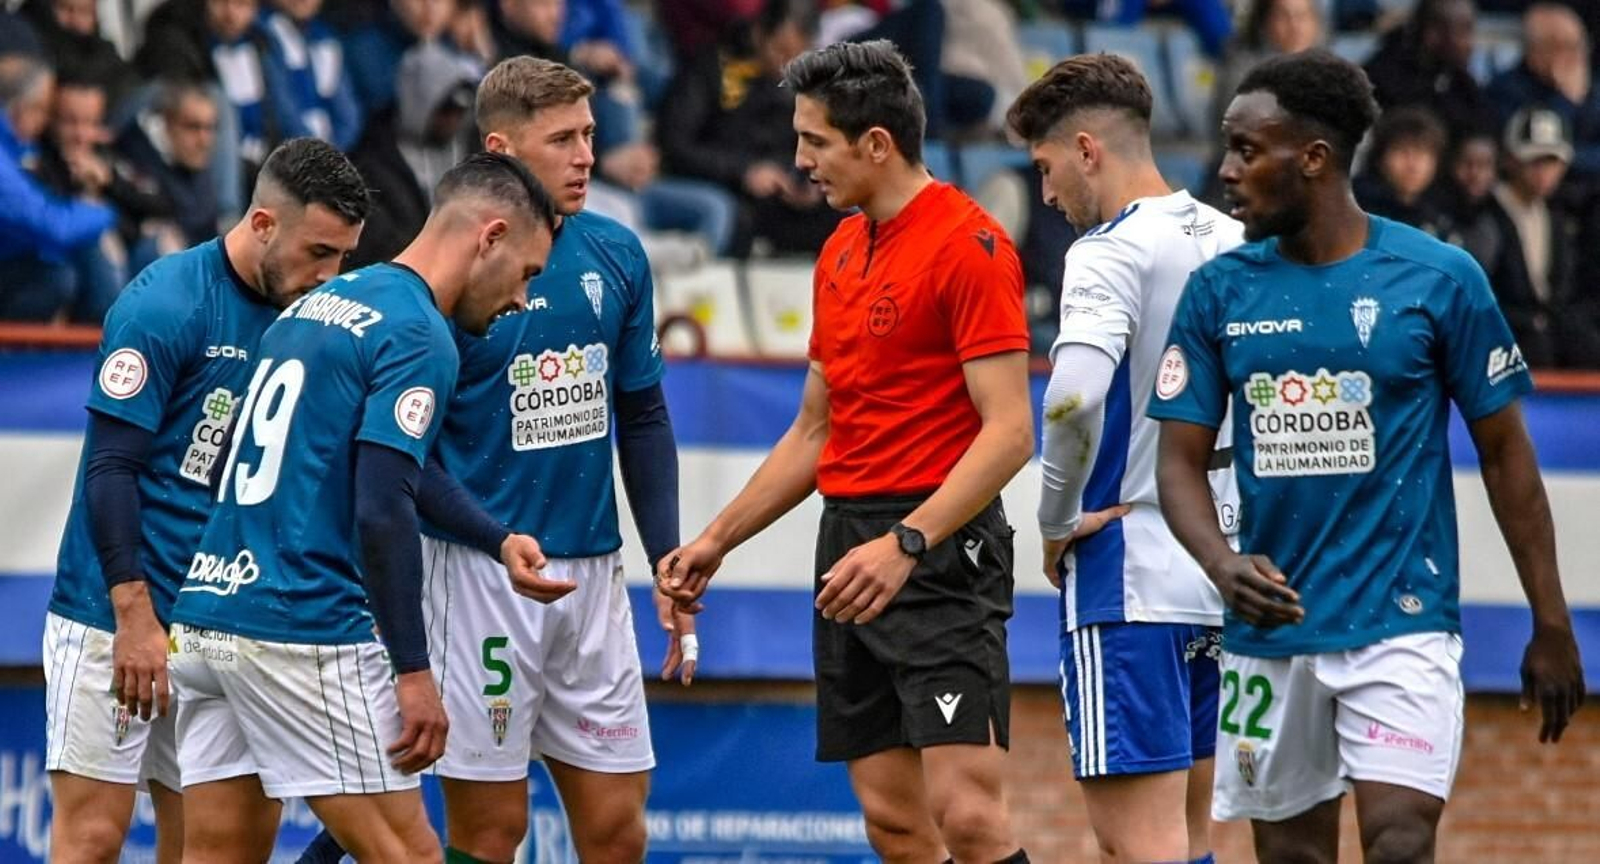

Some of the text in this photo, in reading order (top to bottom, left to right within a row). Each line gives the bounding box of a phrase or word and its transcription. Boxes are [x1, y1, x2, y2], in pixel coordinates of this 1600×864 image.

[295, 288, 383, 338] MÁRQUEZ
[1226, 319, 1303, 337] GIVOVA
[514, 379, 605, 412] CÓRDOBA
[217, 358, 306, 506] 19
[516, 406, 606, 433] PATRIMONIO DE
[1255, 408, 1369, 434] CÓRDOBA
[516, 420, 606, 447] LA HUMANIDAD
[1258, 438, 1370, 455] PATRIMONIO DE
[1258, 454, 1370, 471] LA HUMANIDAD
[184, 639, 201, 654] de
[481, 636, 513, 696] 5
[1220, 669, 1273, 740] 22
